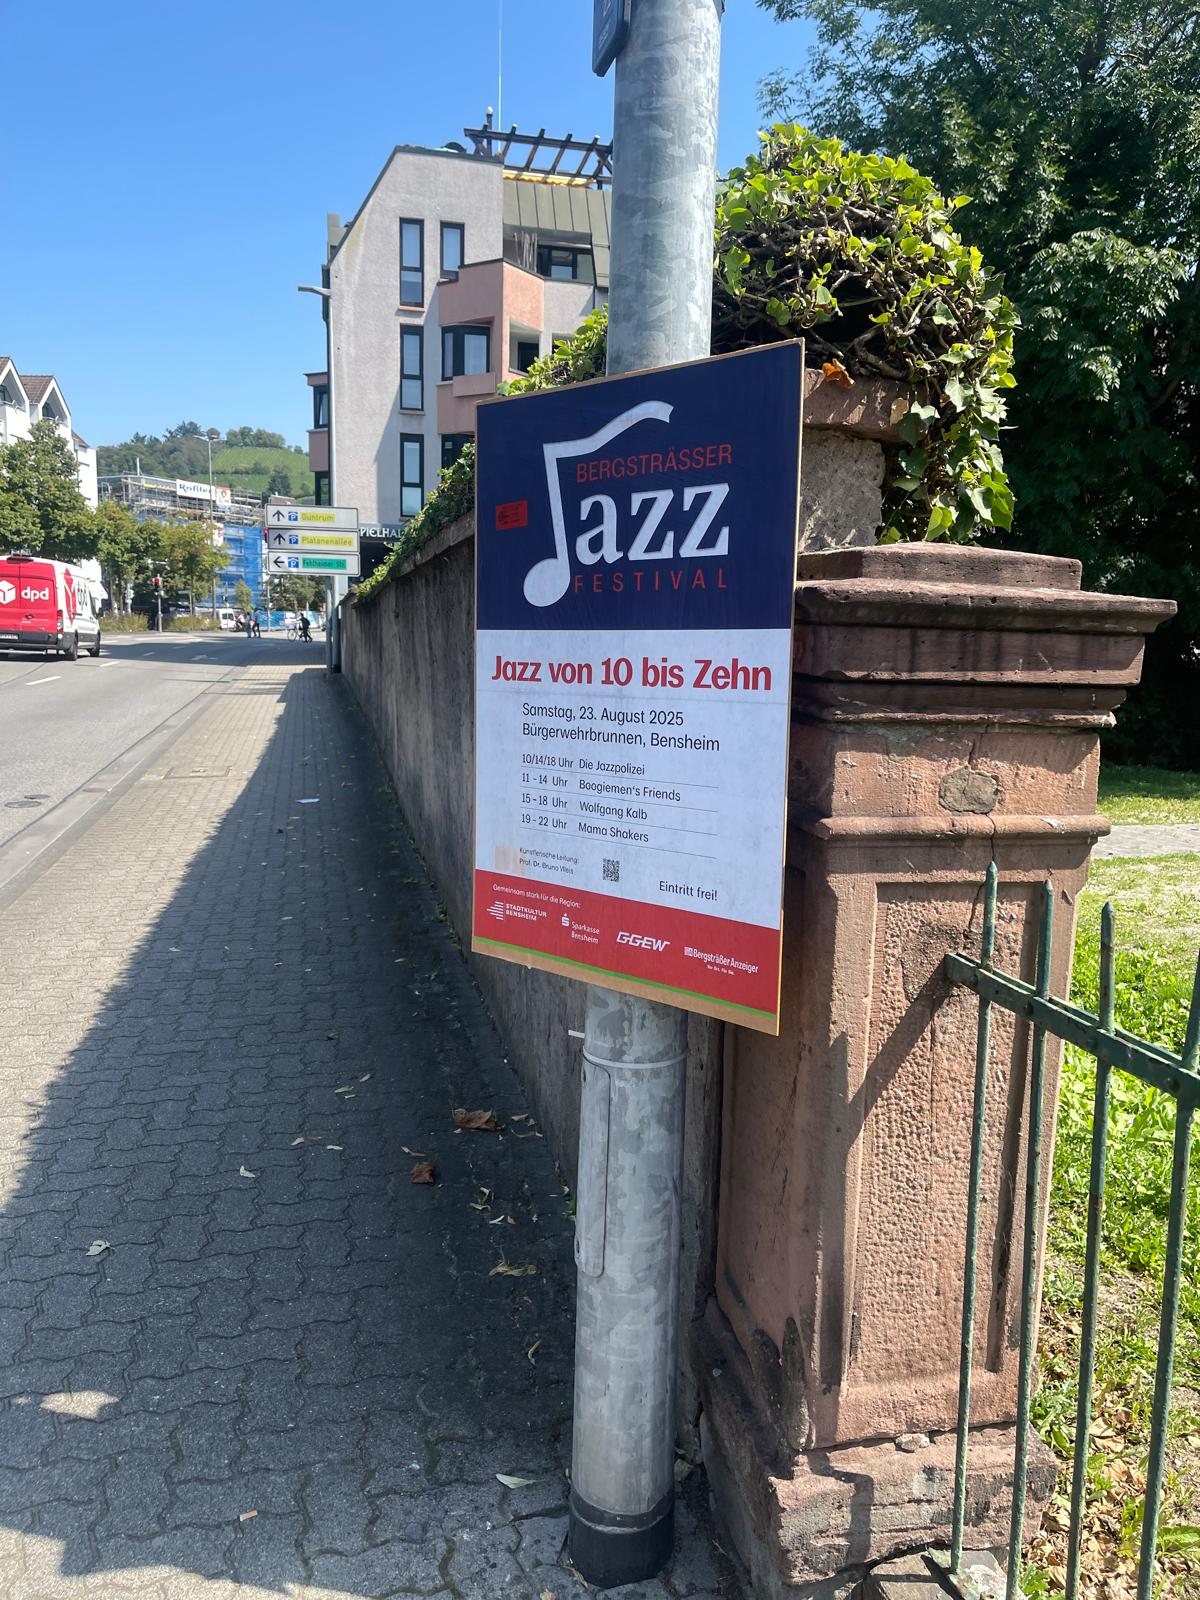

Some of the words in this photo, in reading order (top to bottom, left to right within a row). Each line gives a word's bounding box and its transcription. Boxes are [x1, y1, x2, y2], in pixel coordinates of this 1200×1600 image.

[576, 444, 733, 483] BERGSTRÄSSER
[574, 567, 727, 592] FESTIVAL
[21, 586, 49, 602] dpd
[492, 656, 542, 682] Jazz
[548, 661, 592, 684] von
[601, 657, 633, 686] 10
[642, 656, 684, 689] bis
[692, 658, 772, 691] Zehn
[522, 702, 576, 722] Samstag,
[579, 706, 597, 720] 23.
[601, 708, 645, 725] August
[649, 710, 684, 726] 2025
[522, 722, 646, 747] Bürgerwehrbrunnen,
[650, 733, 720, 752] Bensheim
[522, 753, 556, 767] 10/14/18
[558, 757, 574, 768] Uhr
[579, 758, 593, 770] Die
[596, 760, 645, 775] Jazzpolizei
[522, 773, 530, 783] 11
[539, 775, 548, 785] 14
[552, 776, 568, 787] Uhr
[643, 786, 681, 802] Friends
[522, 793, 530, 804] 15
[539, 795, 548, 806] 18
[552, 797, 568, 809] Uhr
[579, 801, 624, 819] Wolfgang
[626, 807, 647, 820] Kalb
[521, 813, 531, 824] 19
[538, 816, 549, 827] 22
[552, 818, 567, 830] Uhr
[578, 822, 608, 836] Mama
[610, 826, 649, 842] Shakers
[659, 880, 694, 897] Eintritt
[697, 887, 718, 901] frei!
[505, 903, 547, 918] STADTKULTUR
[505, 909, 537, 921] BENSHEIM
[571, 921, 600, 935] Sparkasse
[571, 930, 599, 944] Bensheim
[694, 948, 730, 967] Bergsträßer
[730, 957, 759, 974] Anzeiger
